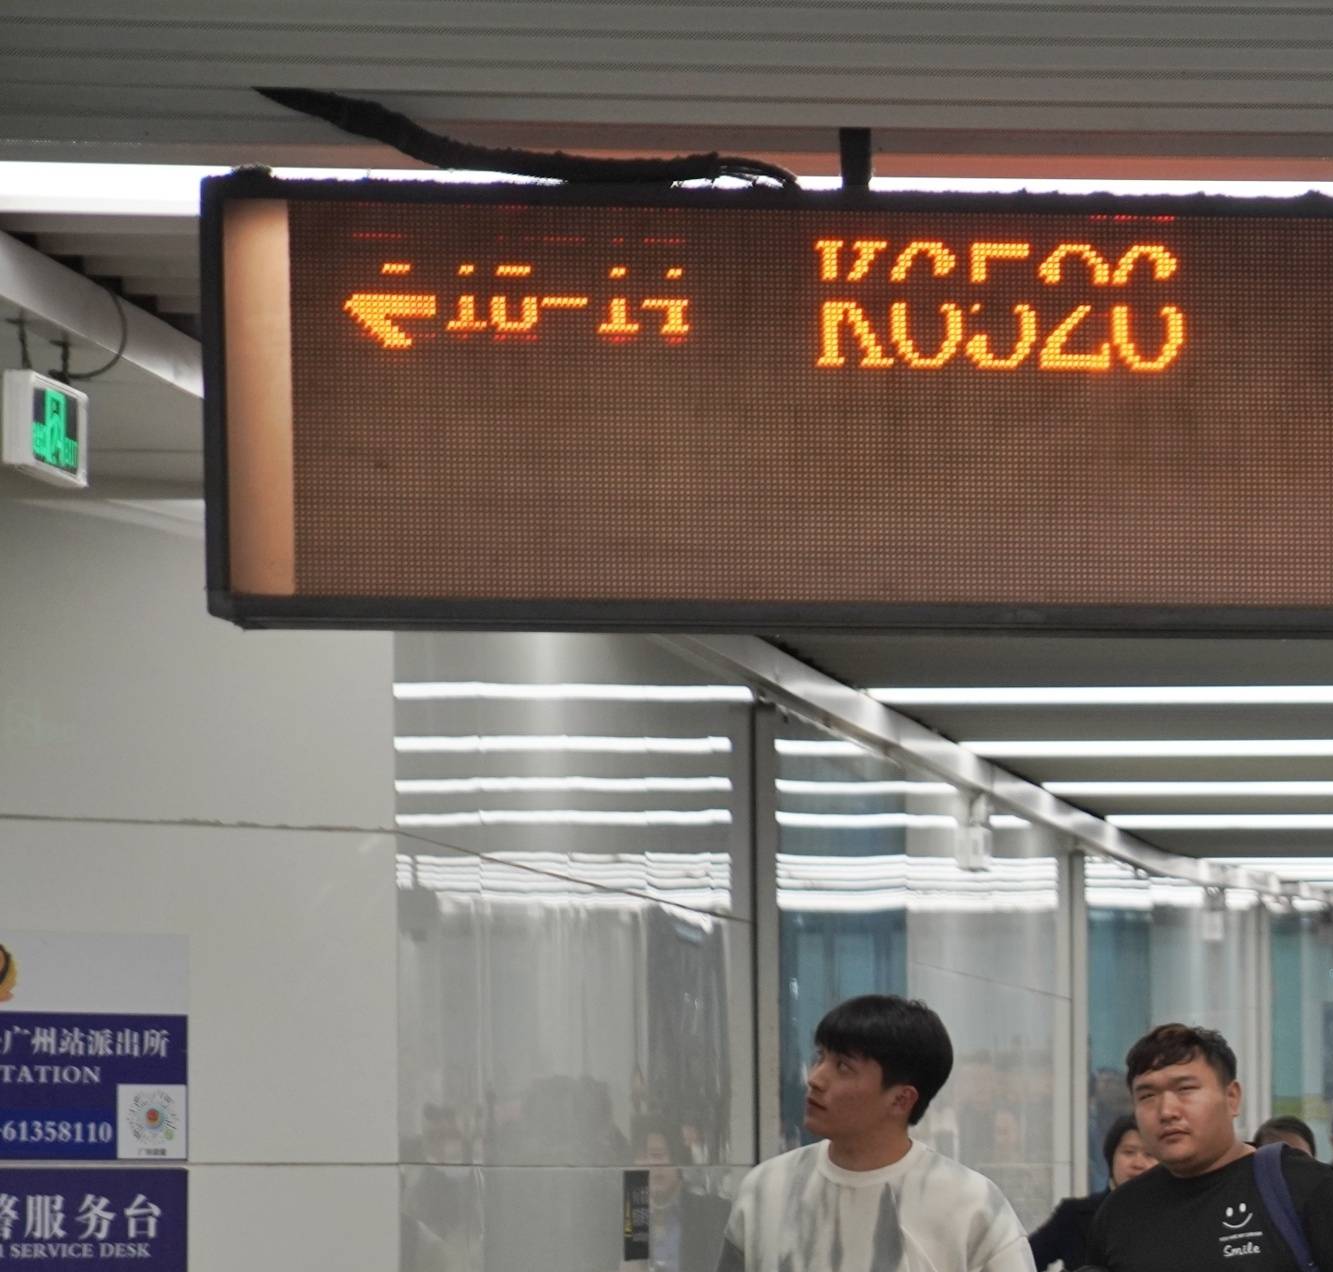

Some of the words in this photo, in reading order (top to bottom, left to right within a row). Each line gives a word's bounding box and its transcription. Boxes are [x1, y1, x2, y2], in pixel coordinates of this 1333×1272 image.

[11, 1243, 94, 1259] SERVICE
[99, 1243, 152, 1259] DESK
[1223, 1241, 1261, 1258] Smile
